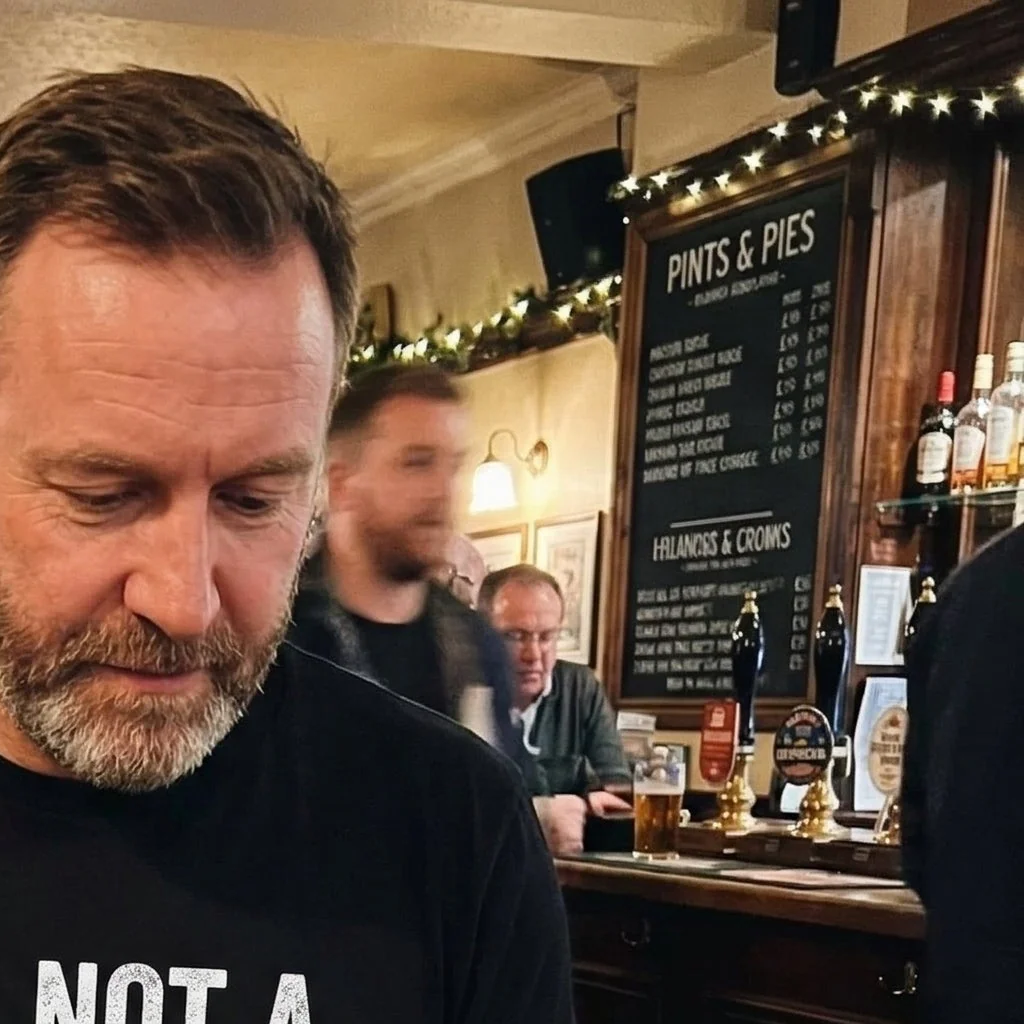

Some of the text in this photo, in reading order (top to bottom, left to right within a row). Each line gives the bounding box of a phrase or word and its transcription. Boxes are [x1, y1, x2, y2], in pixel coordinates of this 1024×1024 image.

[666, 238, 730, 294] PINTS
[736, 229, 754, 272] &
[761, 208, 816, 265] PIES
[721, 529, 733, 555] &
